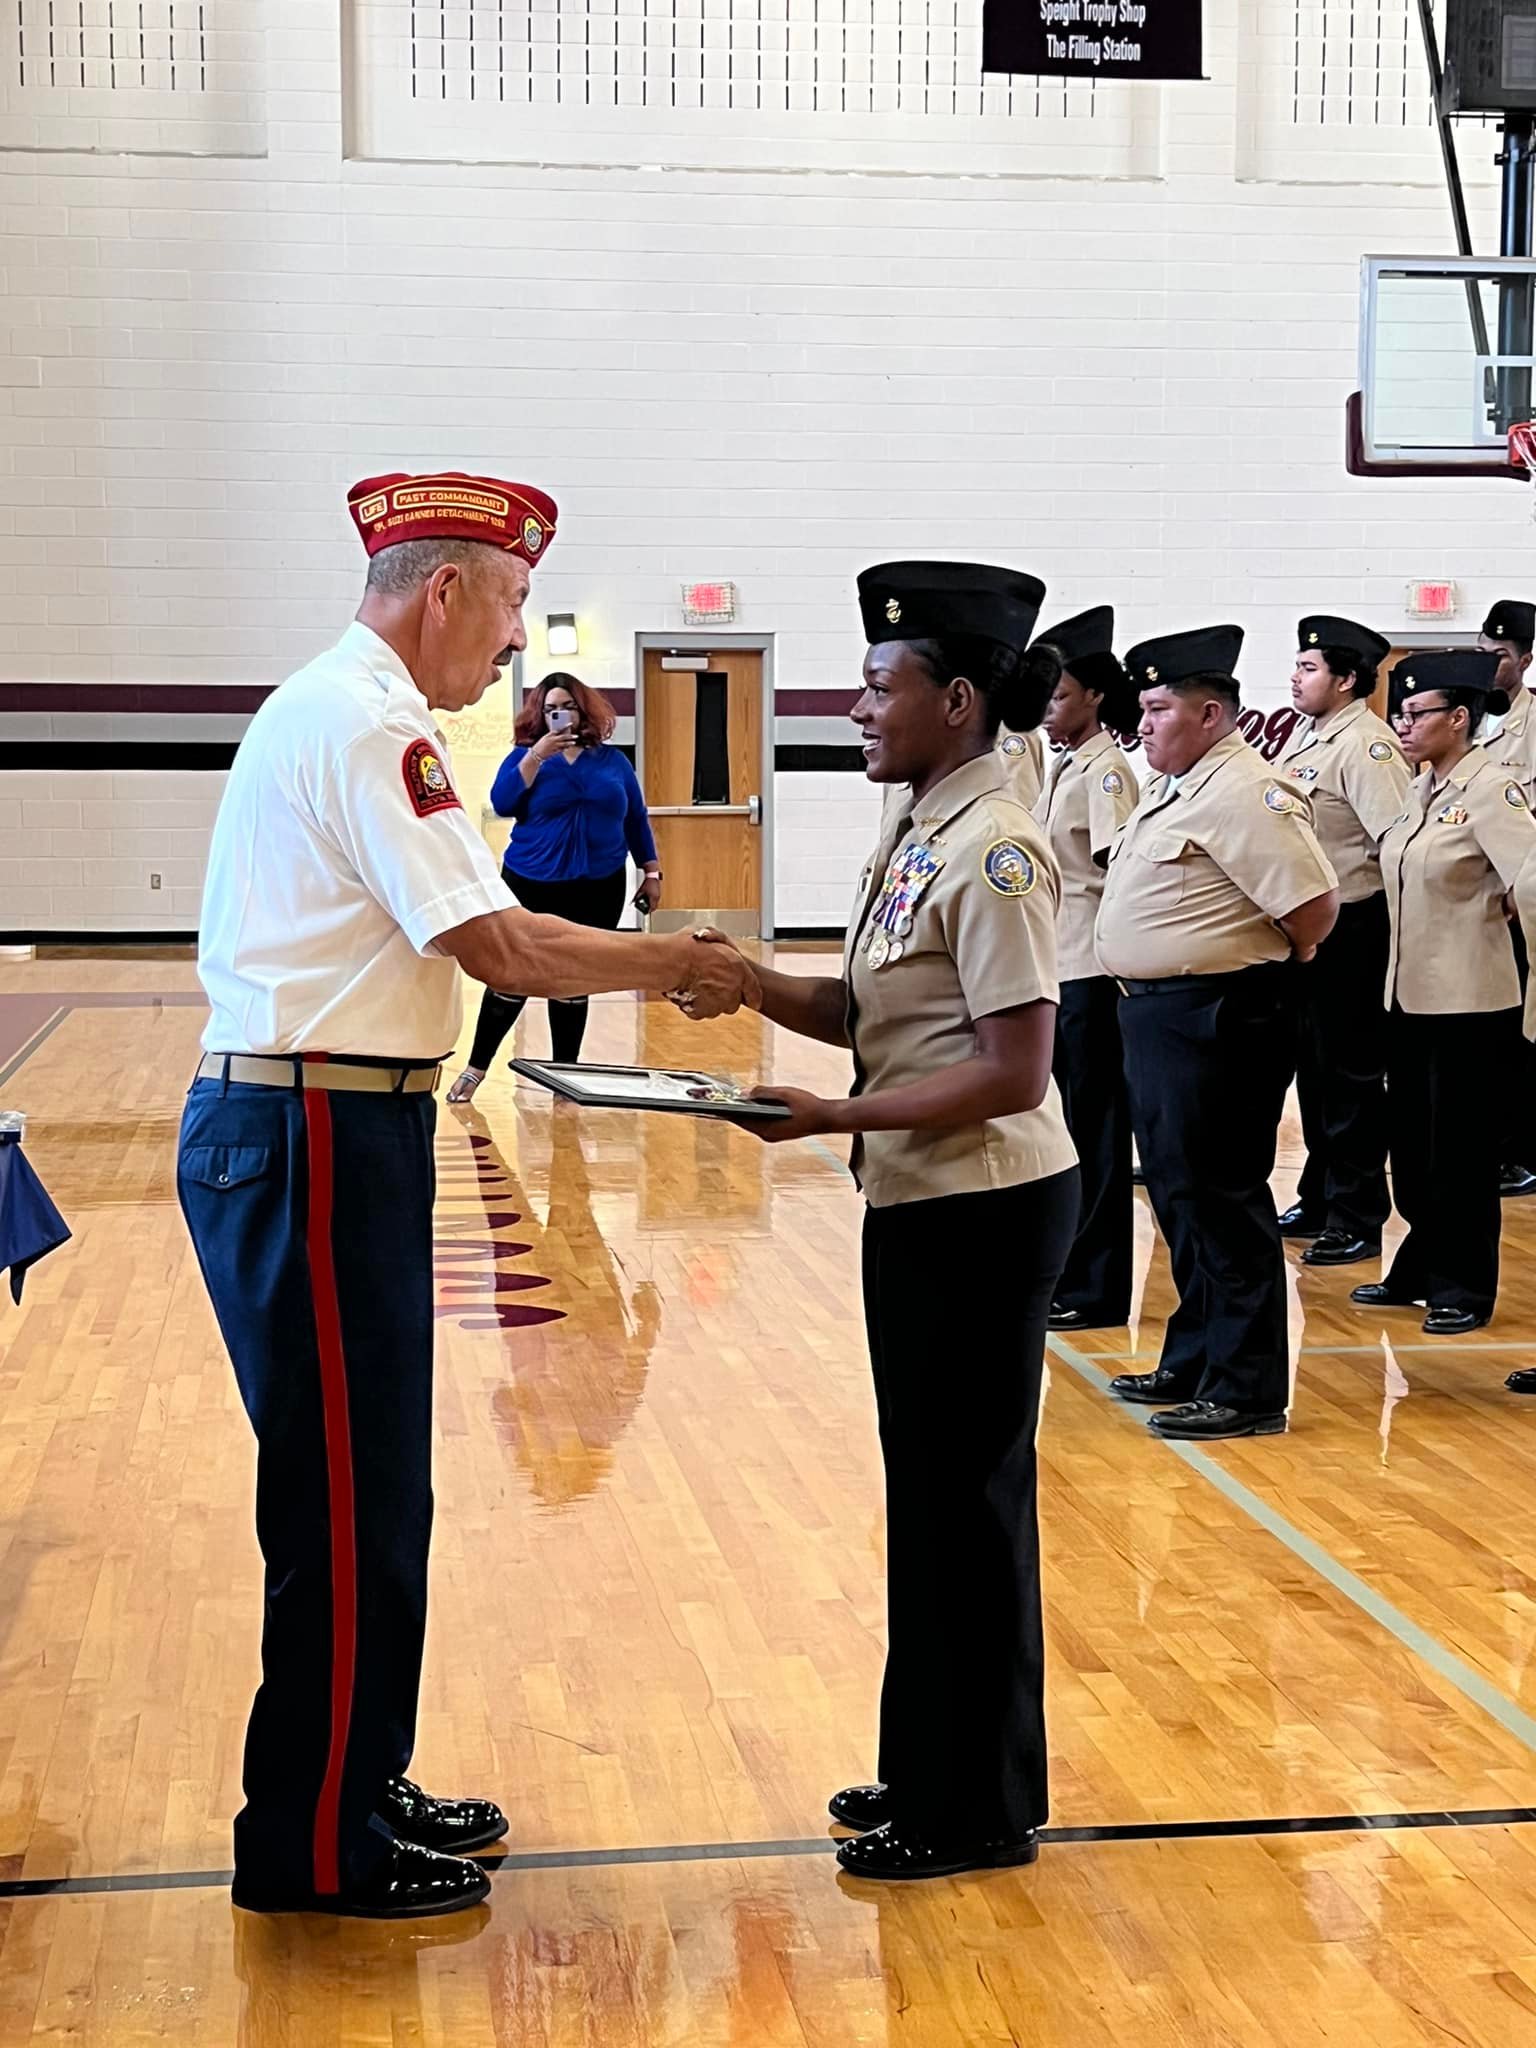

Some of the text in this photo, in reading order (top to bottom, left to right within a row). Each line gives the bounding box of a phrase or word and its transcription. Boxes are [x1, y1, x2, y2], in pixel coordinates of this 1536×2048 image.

[1040, 0, 1146, 28] Speight Trophy Shop
[1046, 34, 1141, 65] The Filling Station
[363, 500, 385, 518] LIFE
[399, 492, 502, 510] PAST COMMANDANT
[437, 508, 490, 524] DETACHMENT
